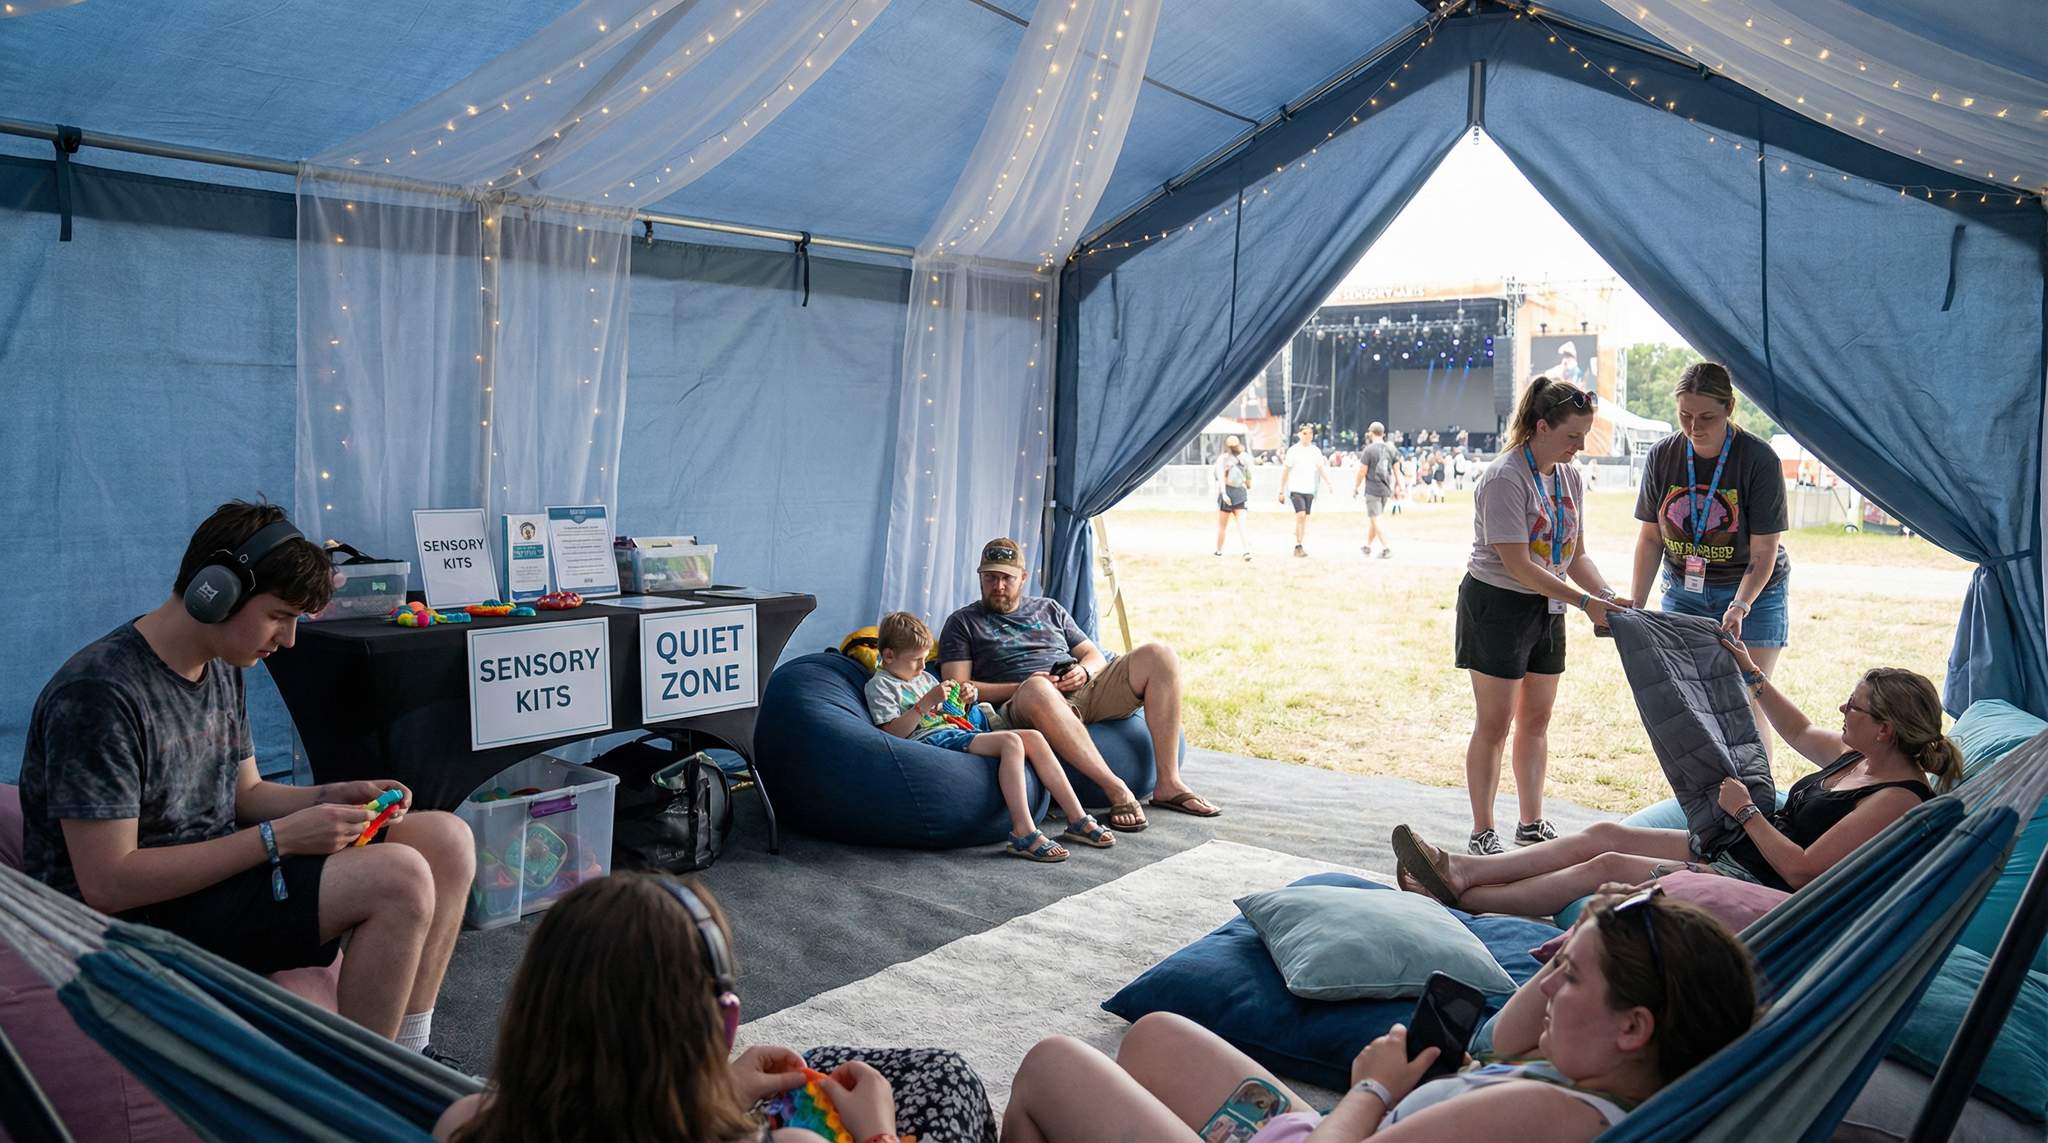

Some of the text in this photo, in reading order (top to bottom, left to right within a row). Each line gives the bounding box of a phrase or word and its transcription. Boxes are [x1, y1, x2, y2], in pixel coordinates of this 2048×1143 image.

[423, 538, 484, 552] SENSORY
[443, 557, 472, 569] KITS
[656, 624, 744, 665] QUIET
[480, 647, 600, 683] SENSORY
[661, 664, 740, 701] ZONE
[516, 685, 572, 714] KITS
